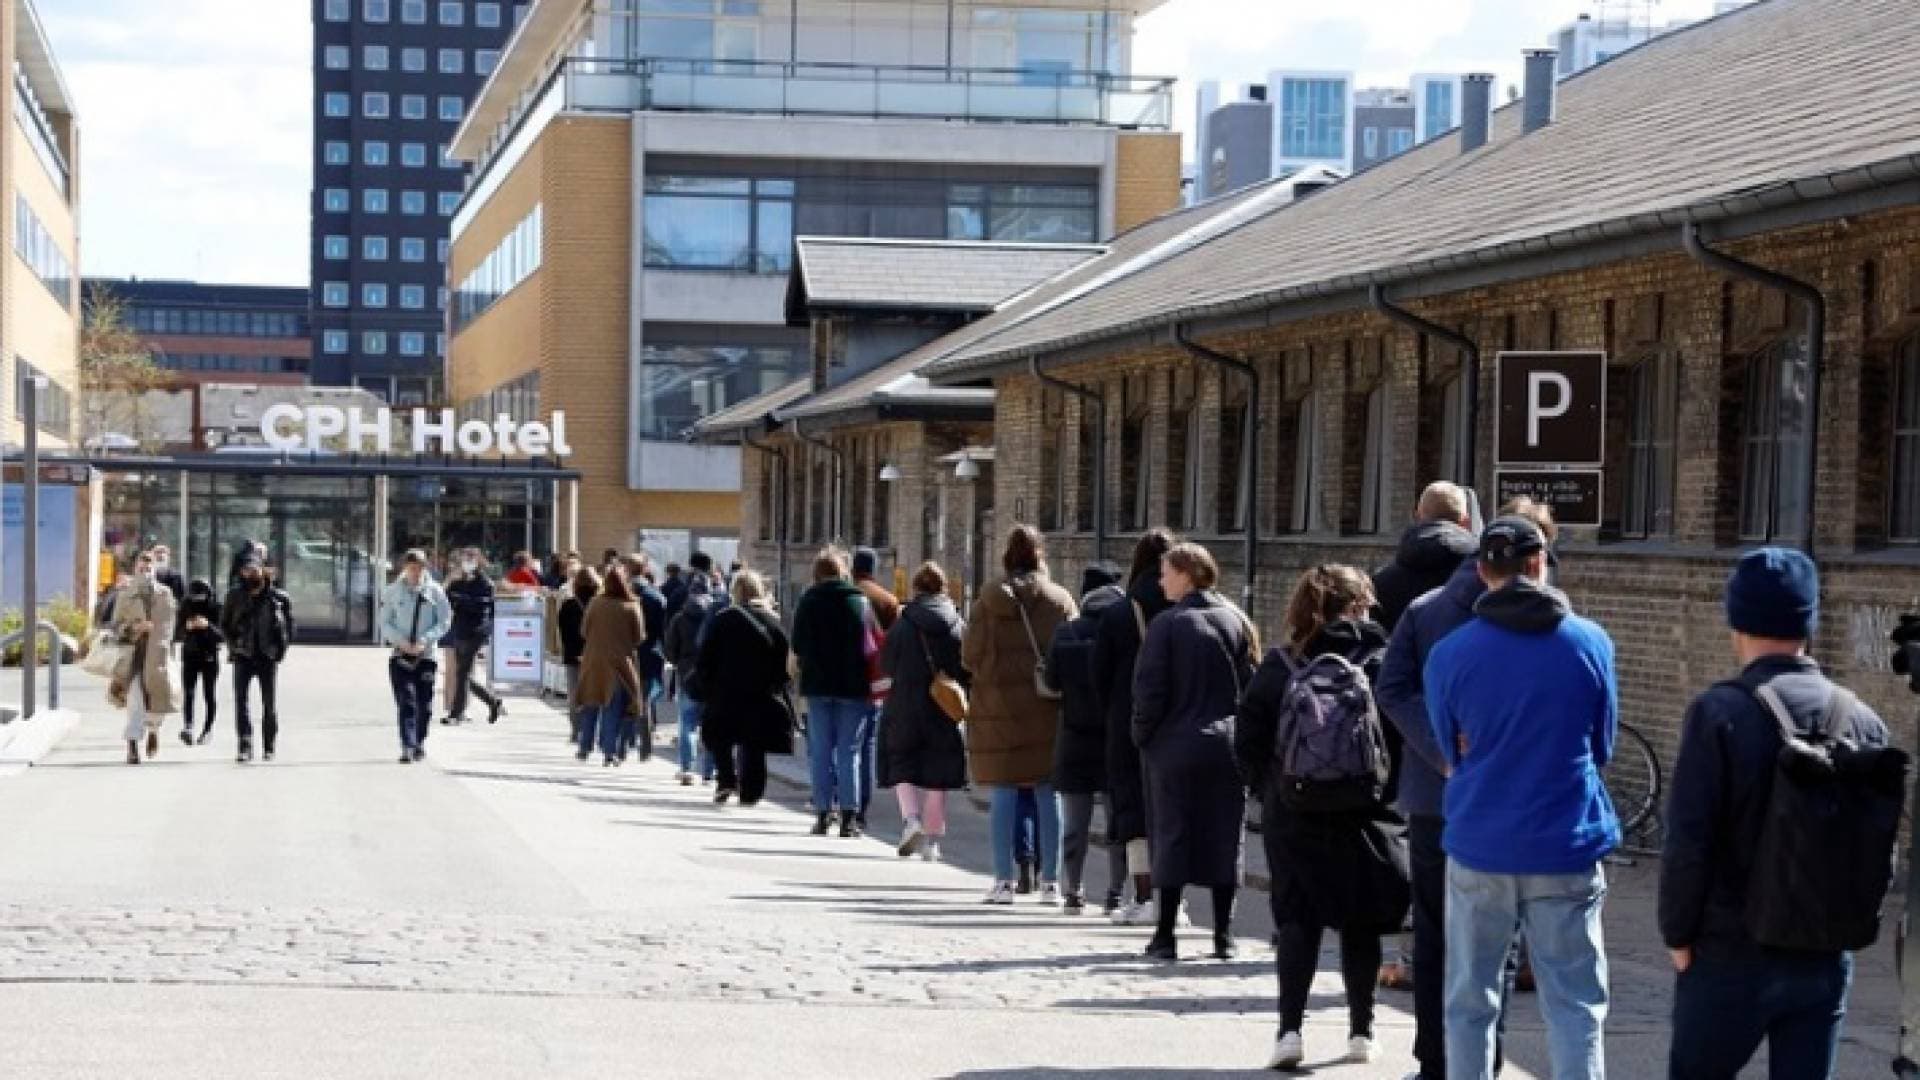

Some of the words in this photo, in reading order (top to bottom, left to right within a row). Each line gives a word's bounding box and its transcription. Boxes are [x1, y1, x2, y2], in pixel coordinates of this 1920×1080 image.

[261, 403, 390, 451] CPH
[413, 406, 571, 456] Hotel
[1527, 372, 1572, 446] P
